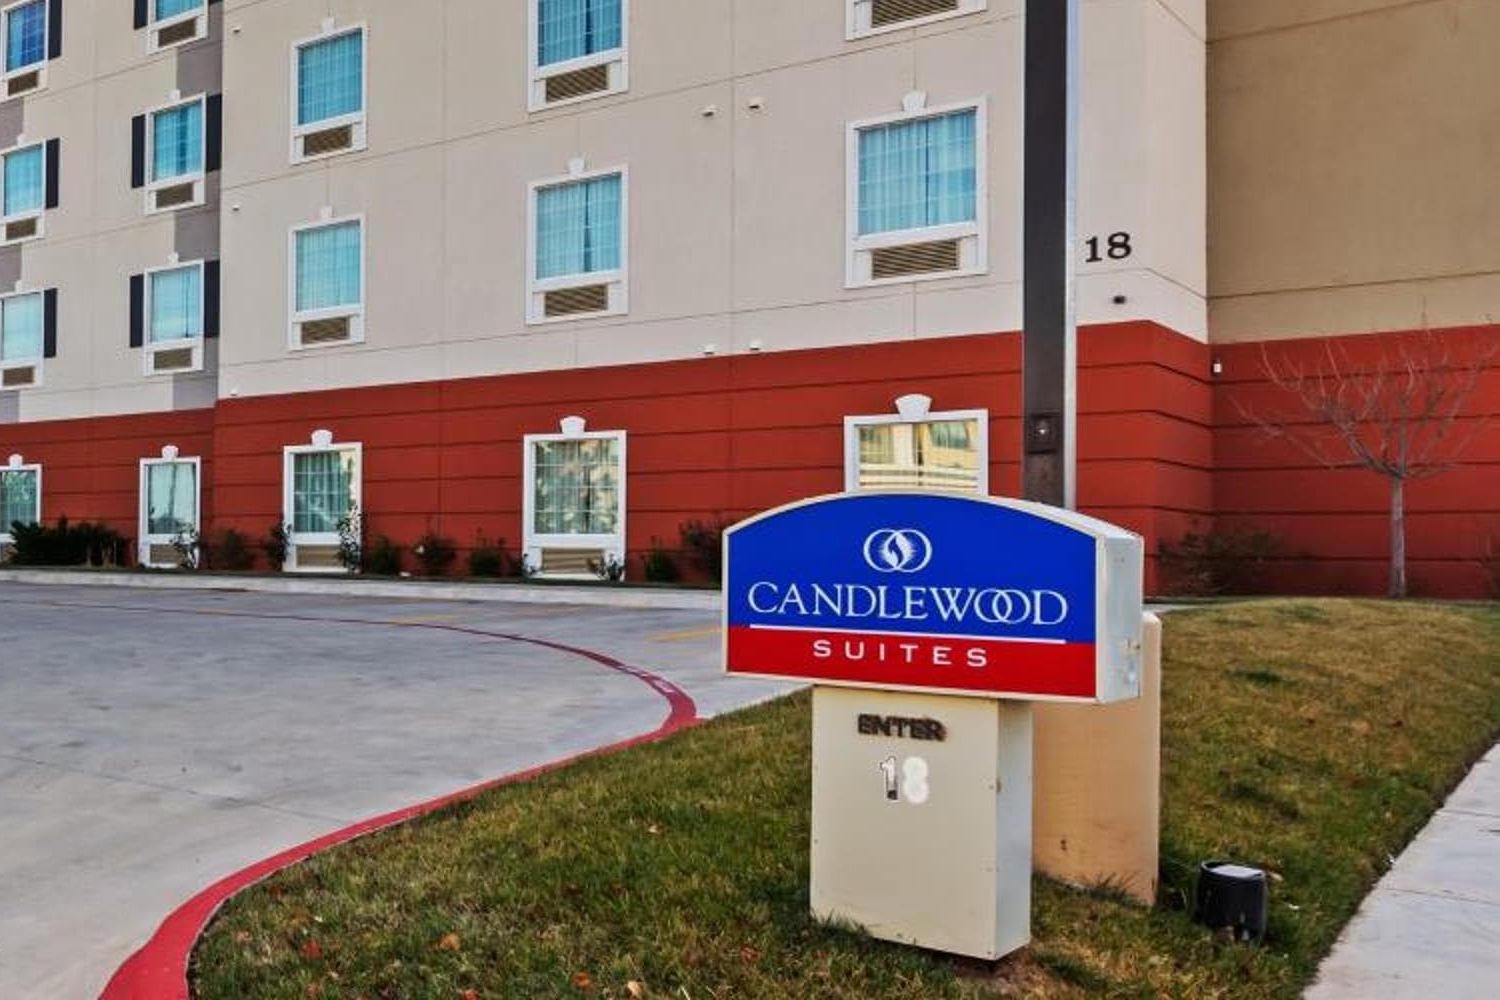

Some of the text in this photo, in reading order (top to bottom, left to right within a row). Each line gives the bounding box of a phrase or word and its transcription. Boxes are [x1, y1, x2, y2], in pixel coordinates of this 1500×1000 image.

[1085, 231, 1132, 263] 18
[748, 581, 1068, 625] CANDLEWOOD
[813, 639, 988, 667] SUITES
[857, 713, 947, 742] ENTER
[880, 755, 929, 804] 18
